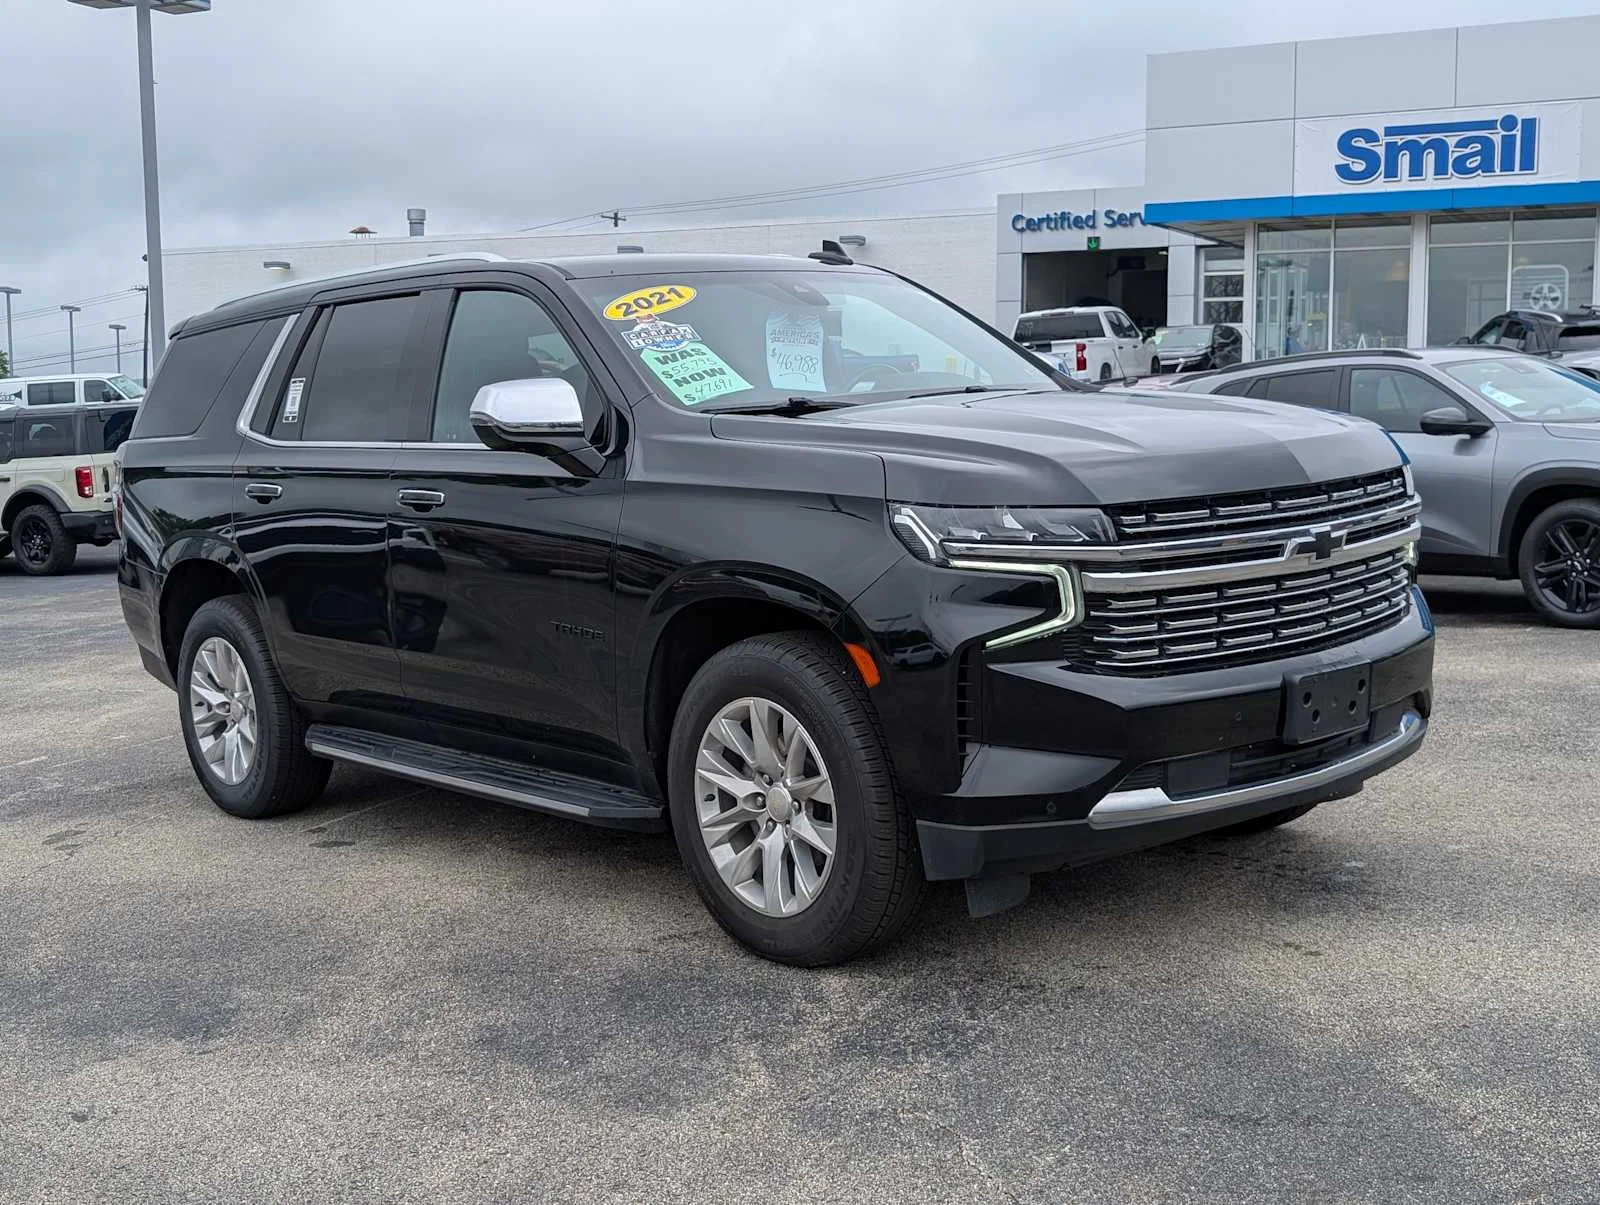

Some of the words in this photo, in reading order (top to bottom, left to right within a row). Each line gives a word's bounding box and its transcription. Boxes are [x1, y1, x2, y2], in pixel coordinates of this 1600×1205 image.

[1334, 113, 1539, 183] Smail
[1011, 209, 1097, 232] Certified
[615, 286, 685, 317] 2021
[654, 347, 707, 366] WAS
[673, 367, 727, 388] NOW
